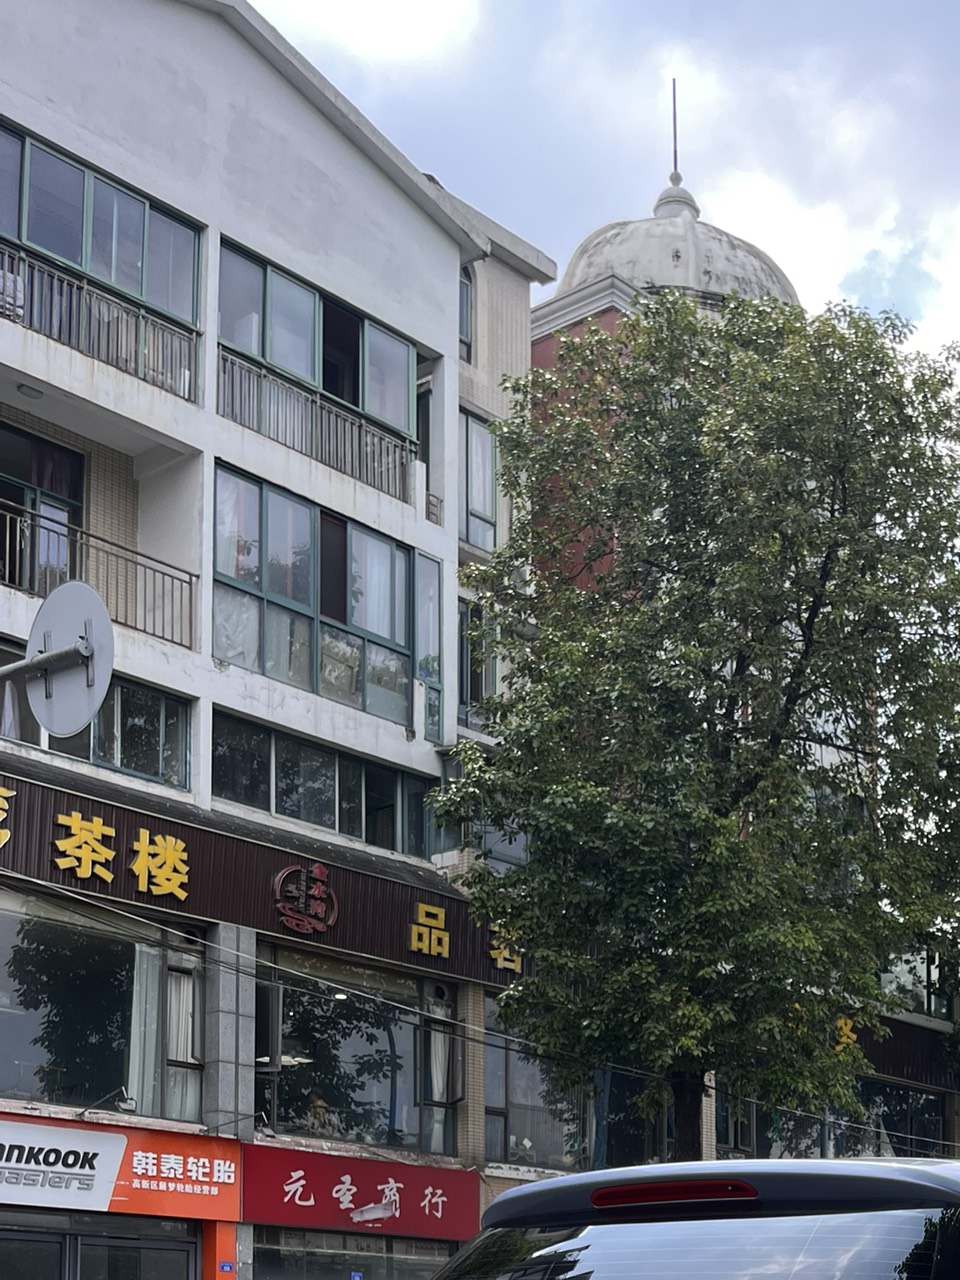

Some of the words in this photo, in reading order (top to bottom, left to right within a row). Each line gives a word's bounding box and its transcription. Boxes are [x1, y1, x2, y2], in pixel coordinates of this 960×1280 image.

[132, 1151, 236, 1183] 韩泰轮胎
[283, 1169, 448, 1219] 元圣商行
